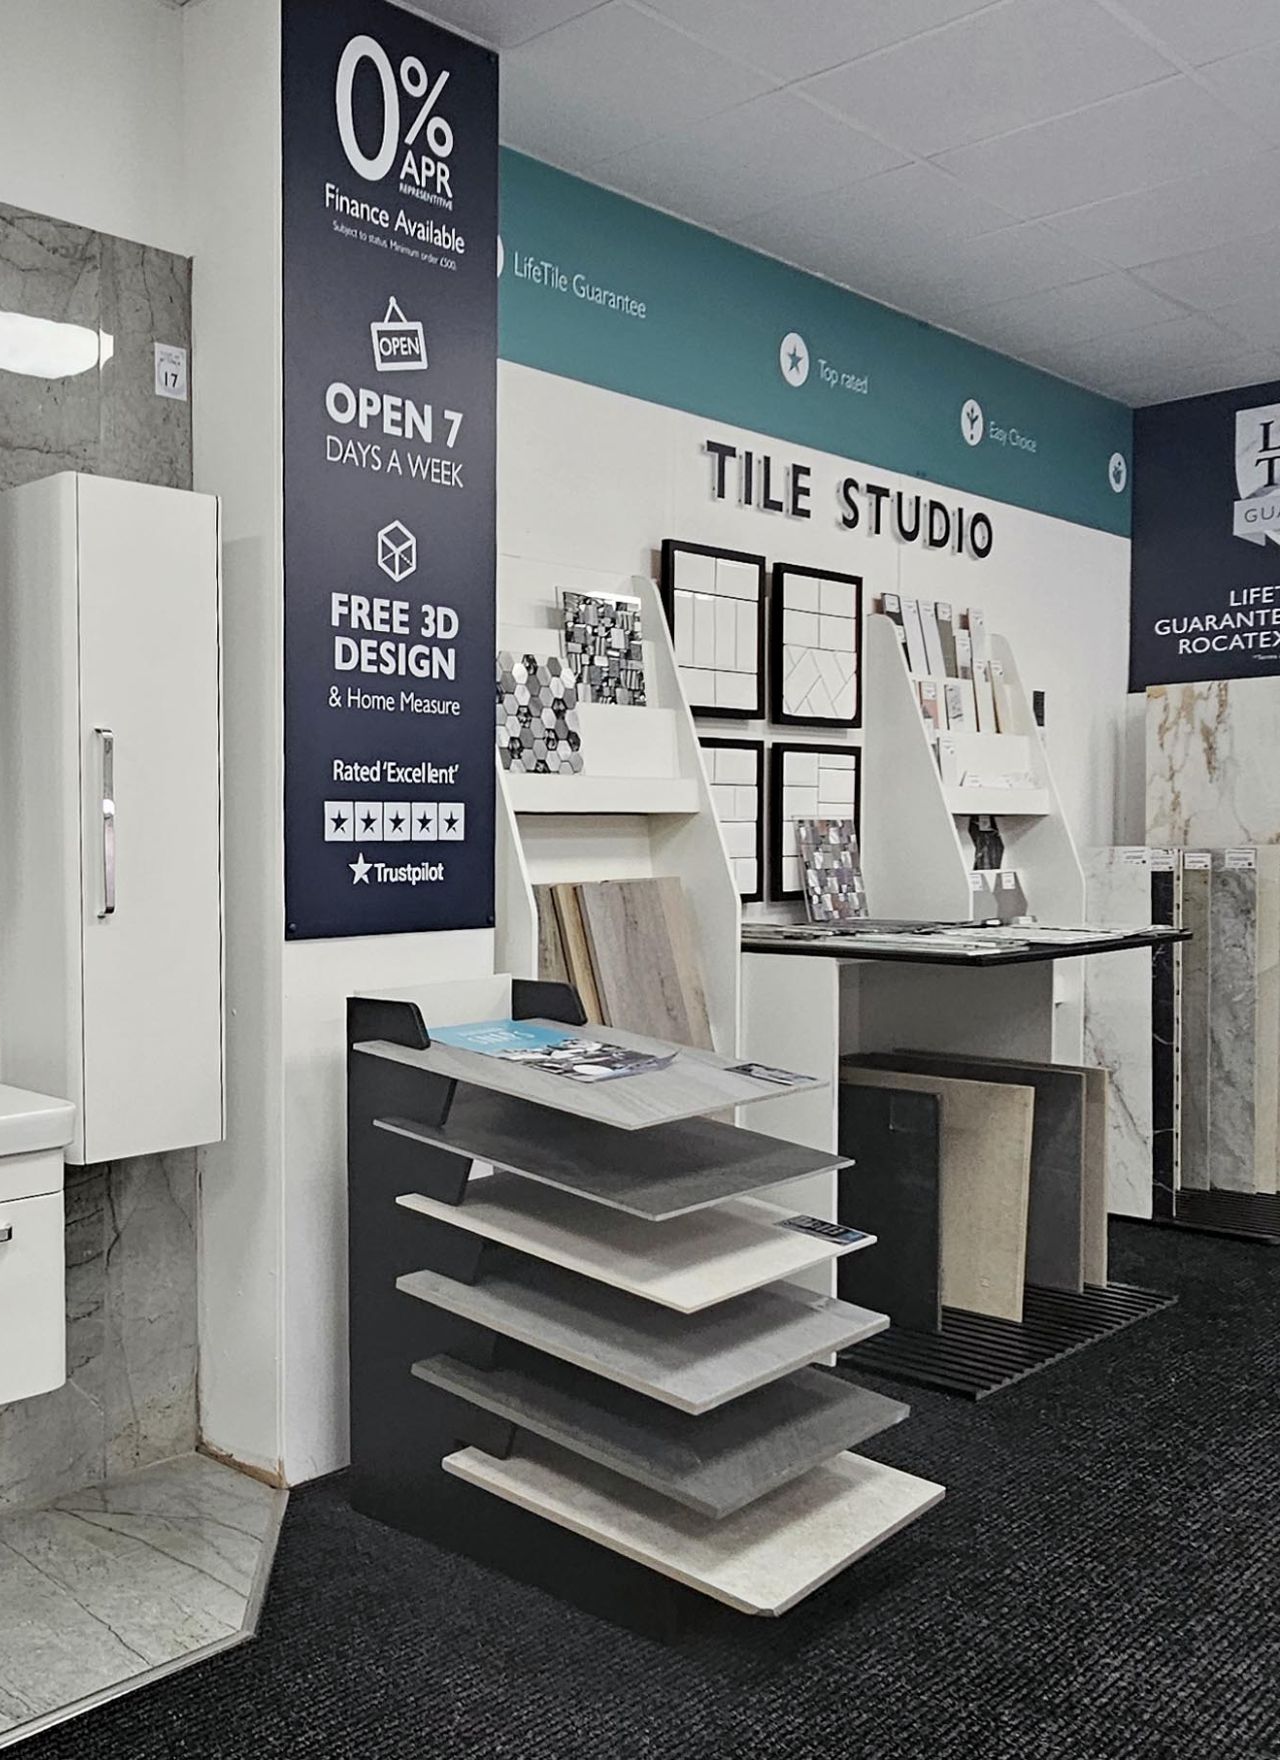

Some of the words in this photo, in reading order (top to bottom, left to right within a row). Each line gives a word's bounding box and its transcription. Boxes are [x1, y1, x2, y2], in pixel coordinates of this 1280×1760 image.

[335, 34, 454, 182] 0%
[399, 149, 453, 199] APR
[324, 182, 390, 229] Finance
[393, 209, 466, 255] Available
[514, 251, 569, 292] LifeTile
[572, 273, 646, 319] Guarantee
[379, 336, 420, 357] OPEN
[164, 370, 179, 389] 17
[817, 358, 839, 389] Top
[840, 373, 868, 395] rated
[325, 381, 433, 444] OPEN
[443, 409, 464, 449] 7
[326, 434, 382, 472] DAYS
[386, 449, 403, 476] A
[407, 452, 464, 489] WEEK
[706, 440, 811, 519] TILE
[841, 477, 993, 559] STUDIO
[1244, 506, 1280, 523] GU
[330, 592, 410, 635] FREE
[420, 604, 459, 640] 3D
[334, 636, 456, 681] DESIGN
[328, 685, 342, 708] &
[347, 687, 395, 712] Home
[400, 691, 461, 716] Measure
[333, 759, 381, 783] Rated
[374, 862, 444, 886] Trustpilot
